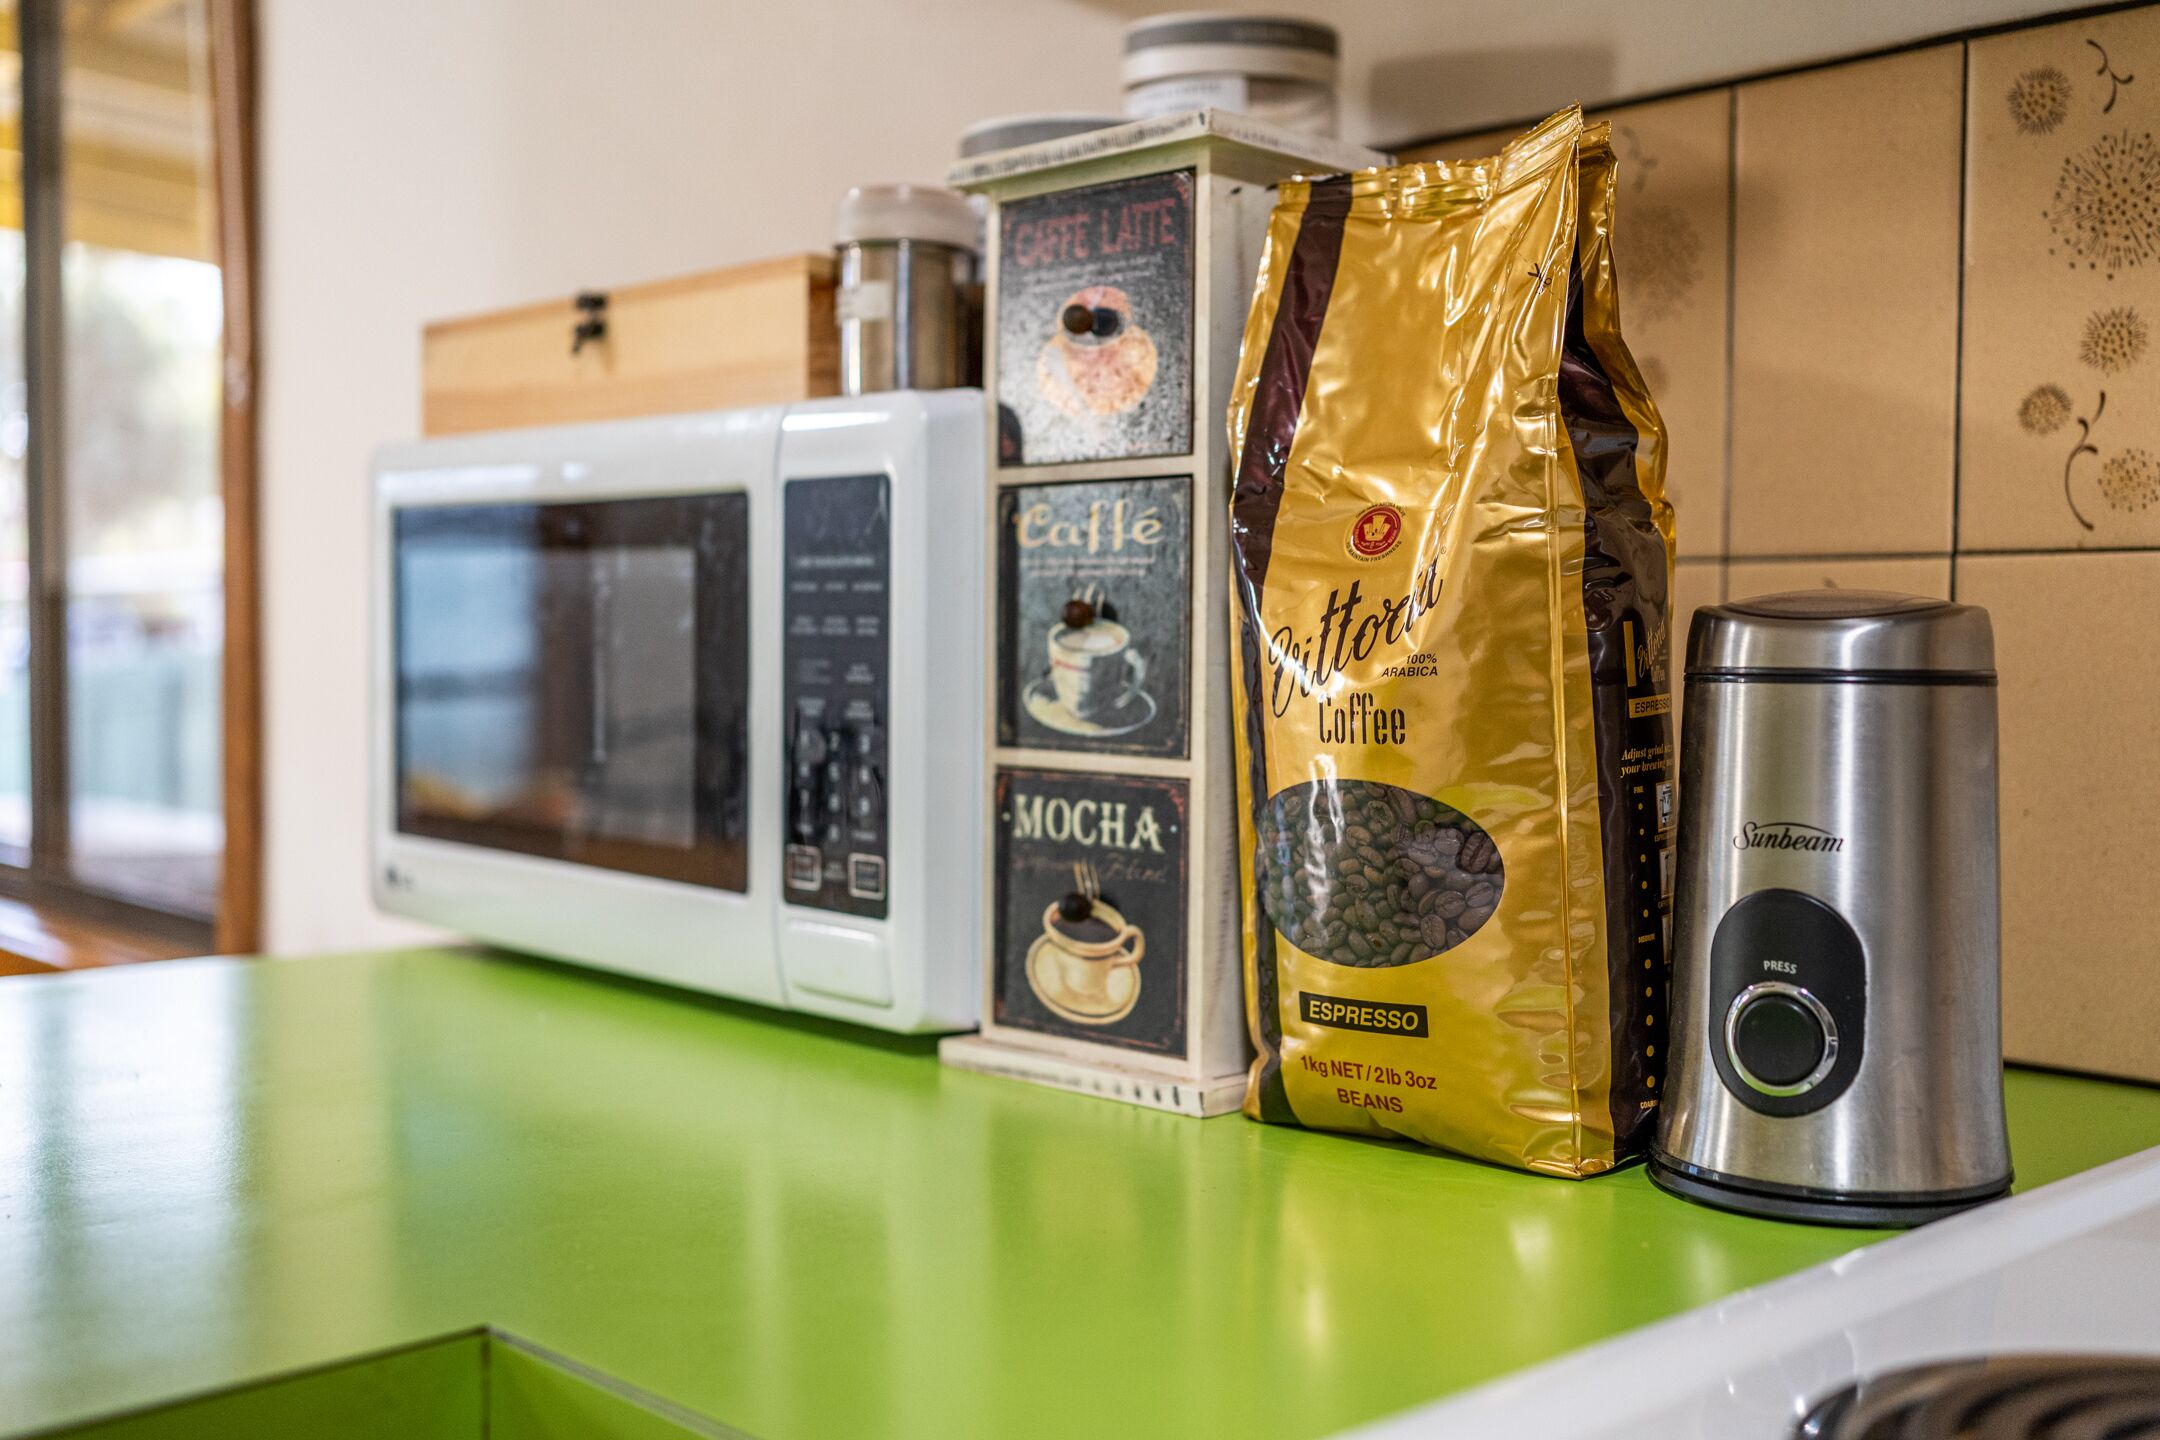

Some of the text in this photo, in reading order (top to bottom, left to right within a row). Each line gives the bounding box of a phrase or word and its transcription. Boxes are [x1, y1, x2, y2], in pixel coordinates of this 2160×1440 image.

[1102, 198, 1176, 254] LATTE
[1381, 665, 1439, 679] ARABICA
[1406, 652, 1438, 665] 100%
[1318, 692, 1406, 745] Coffee
[1620, 765, 1641, 779] your
[1013, 794, 1165, 853] MOCHA
[1733, 821, 1844, 852] Sunbeam
[1763, 960, 1798, 975] PRESS
[1309, 1001, 1418, 1031] ESPRESSO
[1301, 1055, 1328, 1078] 1kg
[1331, 1060, 1363, 1080] NET
[1374, 1066, 1401, 1086] 2lb
[1405, 1070, 1437, 1090] 3oz
[1337, 1088, 1403, 1113] BEANS
